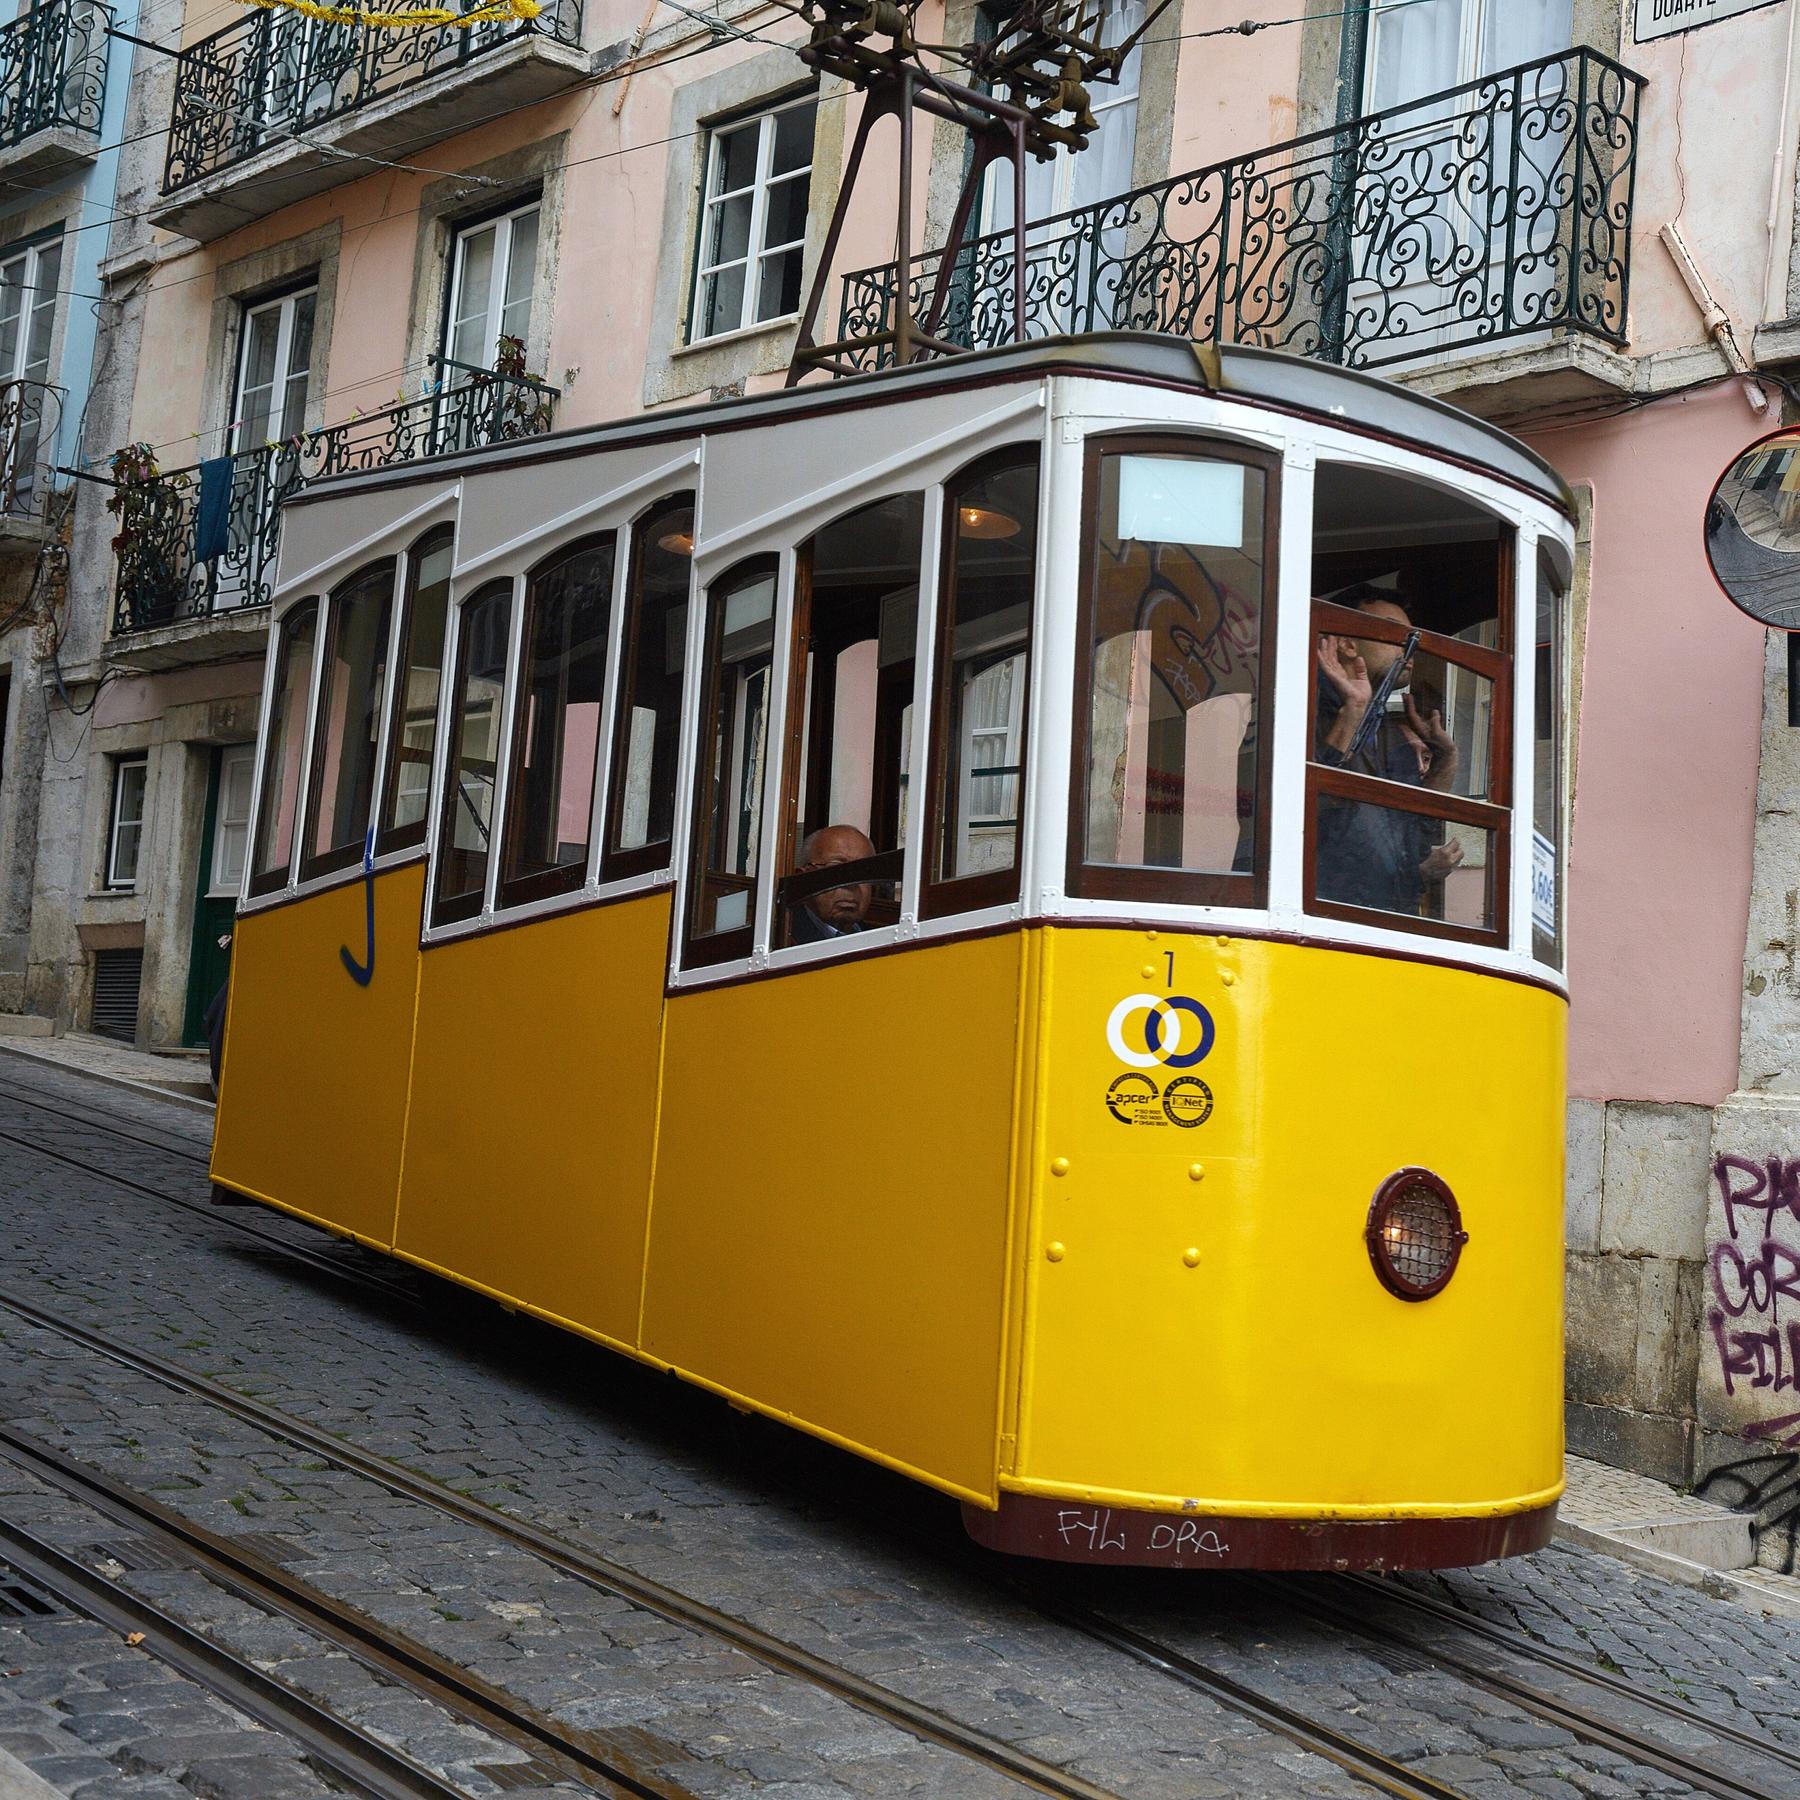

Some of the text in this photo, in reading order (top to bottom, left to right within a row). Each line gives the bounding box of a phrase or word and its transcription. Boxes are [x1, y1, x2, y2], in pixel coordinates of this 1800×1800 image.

[1652, 0, 1717, 21] DUAR
[1162, 950, 1174, 988] 1
[1115, 1093, 1151, 1107] apcer
